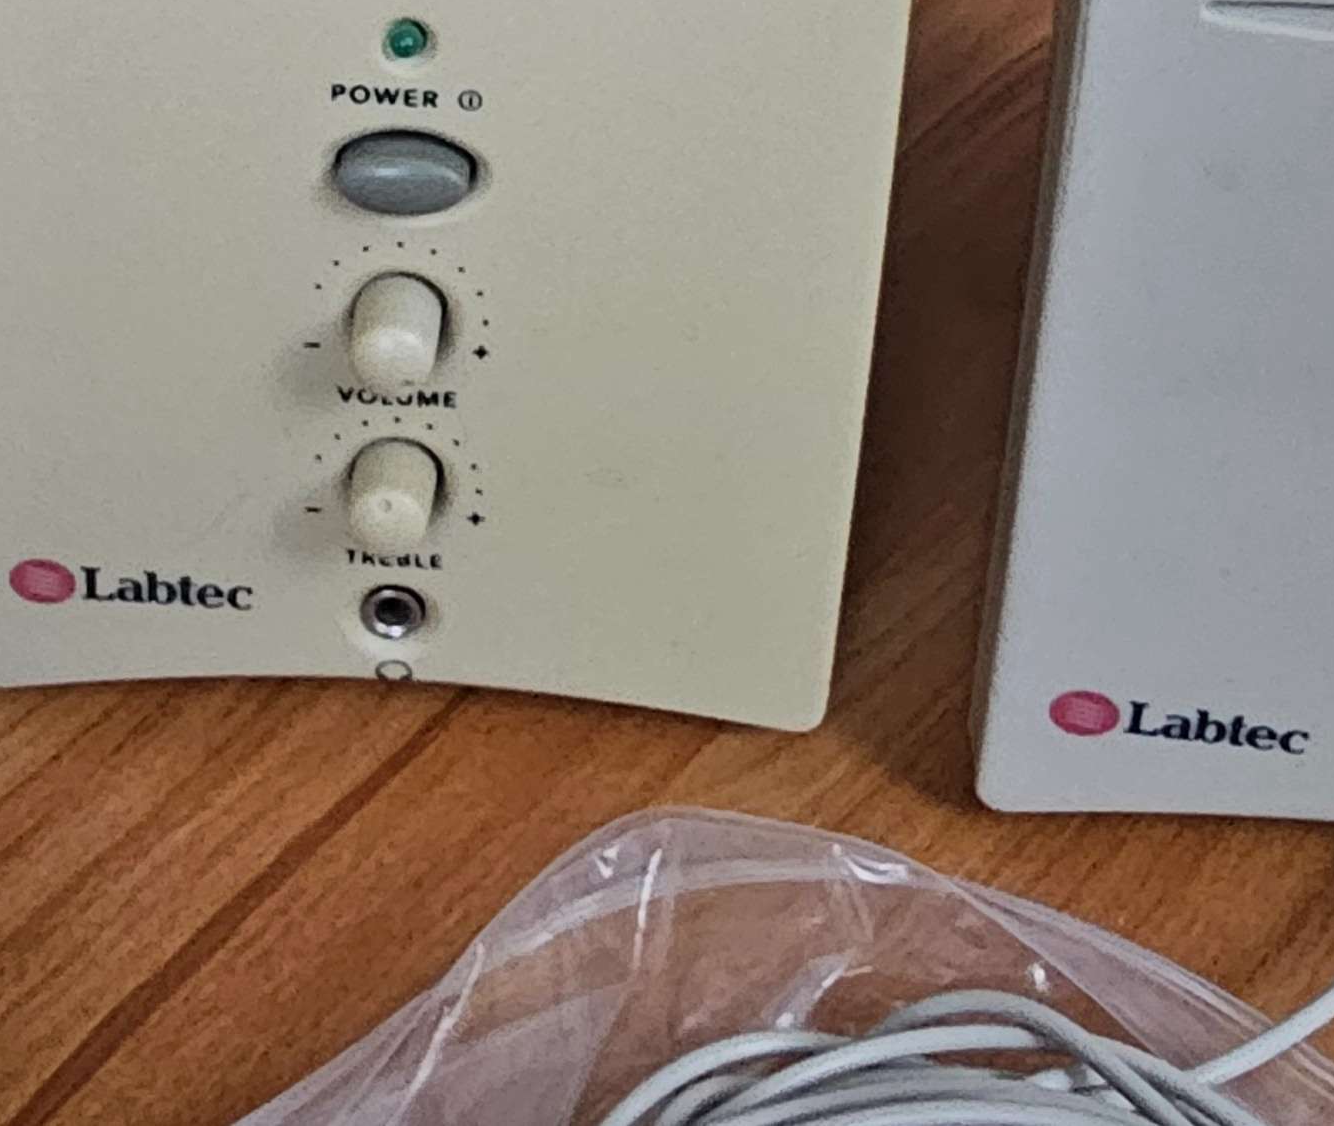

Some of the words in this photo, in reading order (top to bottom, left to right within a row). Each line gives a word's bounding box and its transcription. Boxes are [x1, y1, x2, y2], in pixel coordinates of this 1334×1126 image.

[331, 84, 439, 108] POWER
[80, 566, 254, 611] Labtec
[1123, 700, 1310, 755] Labtec
